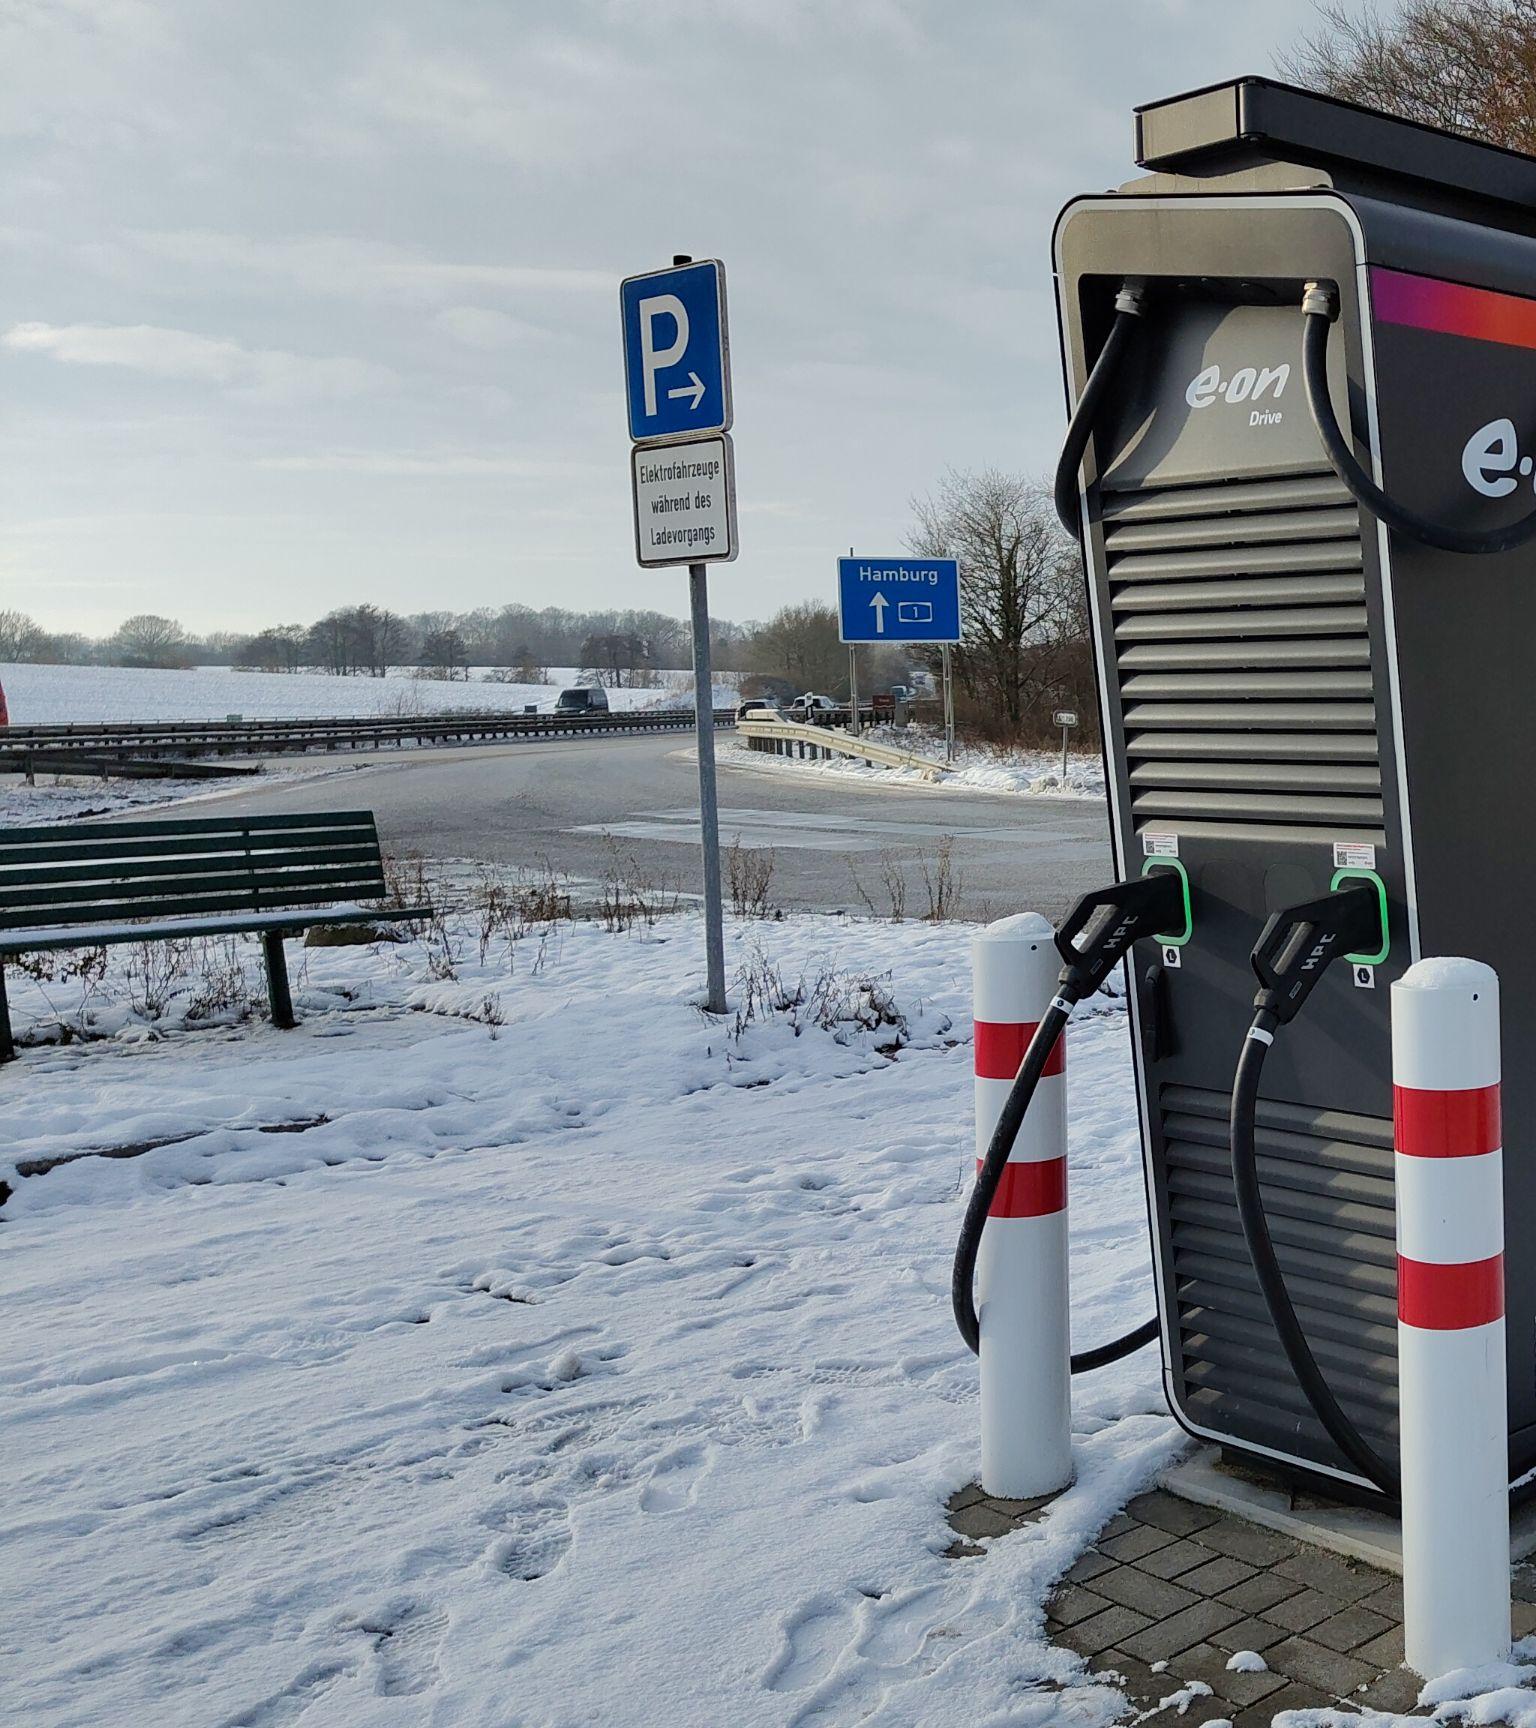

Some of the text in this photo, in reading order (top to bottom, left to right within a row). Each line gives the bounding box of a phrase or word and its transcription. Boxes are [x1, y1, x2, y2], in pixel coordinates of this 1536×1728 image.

[638, 294, 690, 417] P
[1248, 408, 1283, 427] Drive
[640, 460, 720, 484] Elektrofahrzeuge
[651, 490, 712, 514] während des
[650, 526, 715, 547] Ladevorgangs
[859, 566, 938, 586] Hamburg
[912, 606, 918, 618] 1
